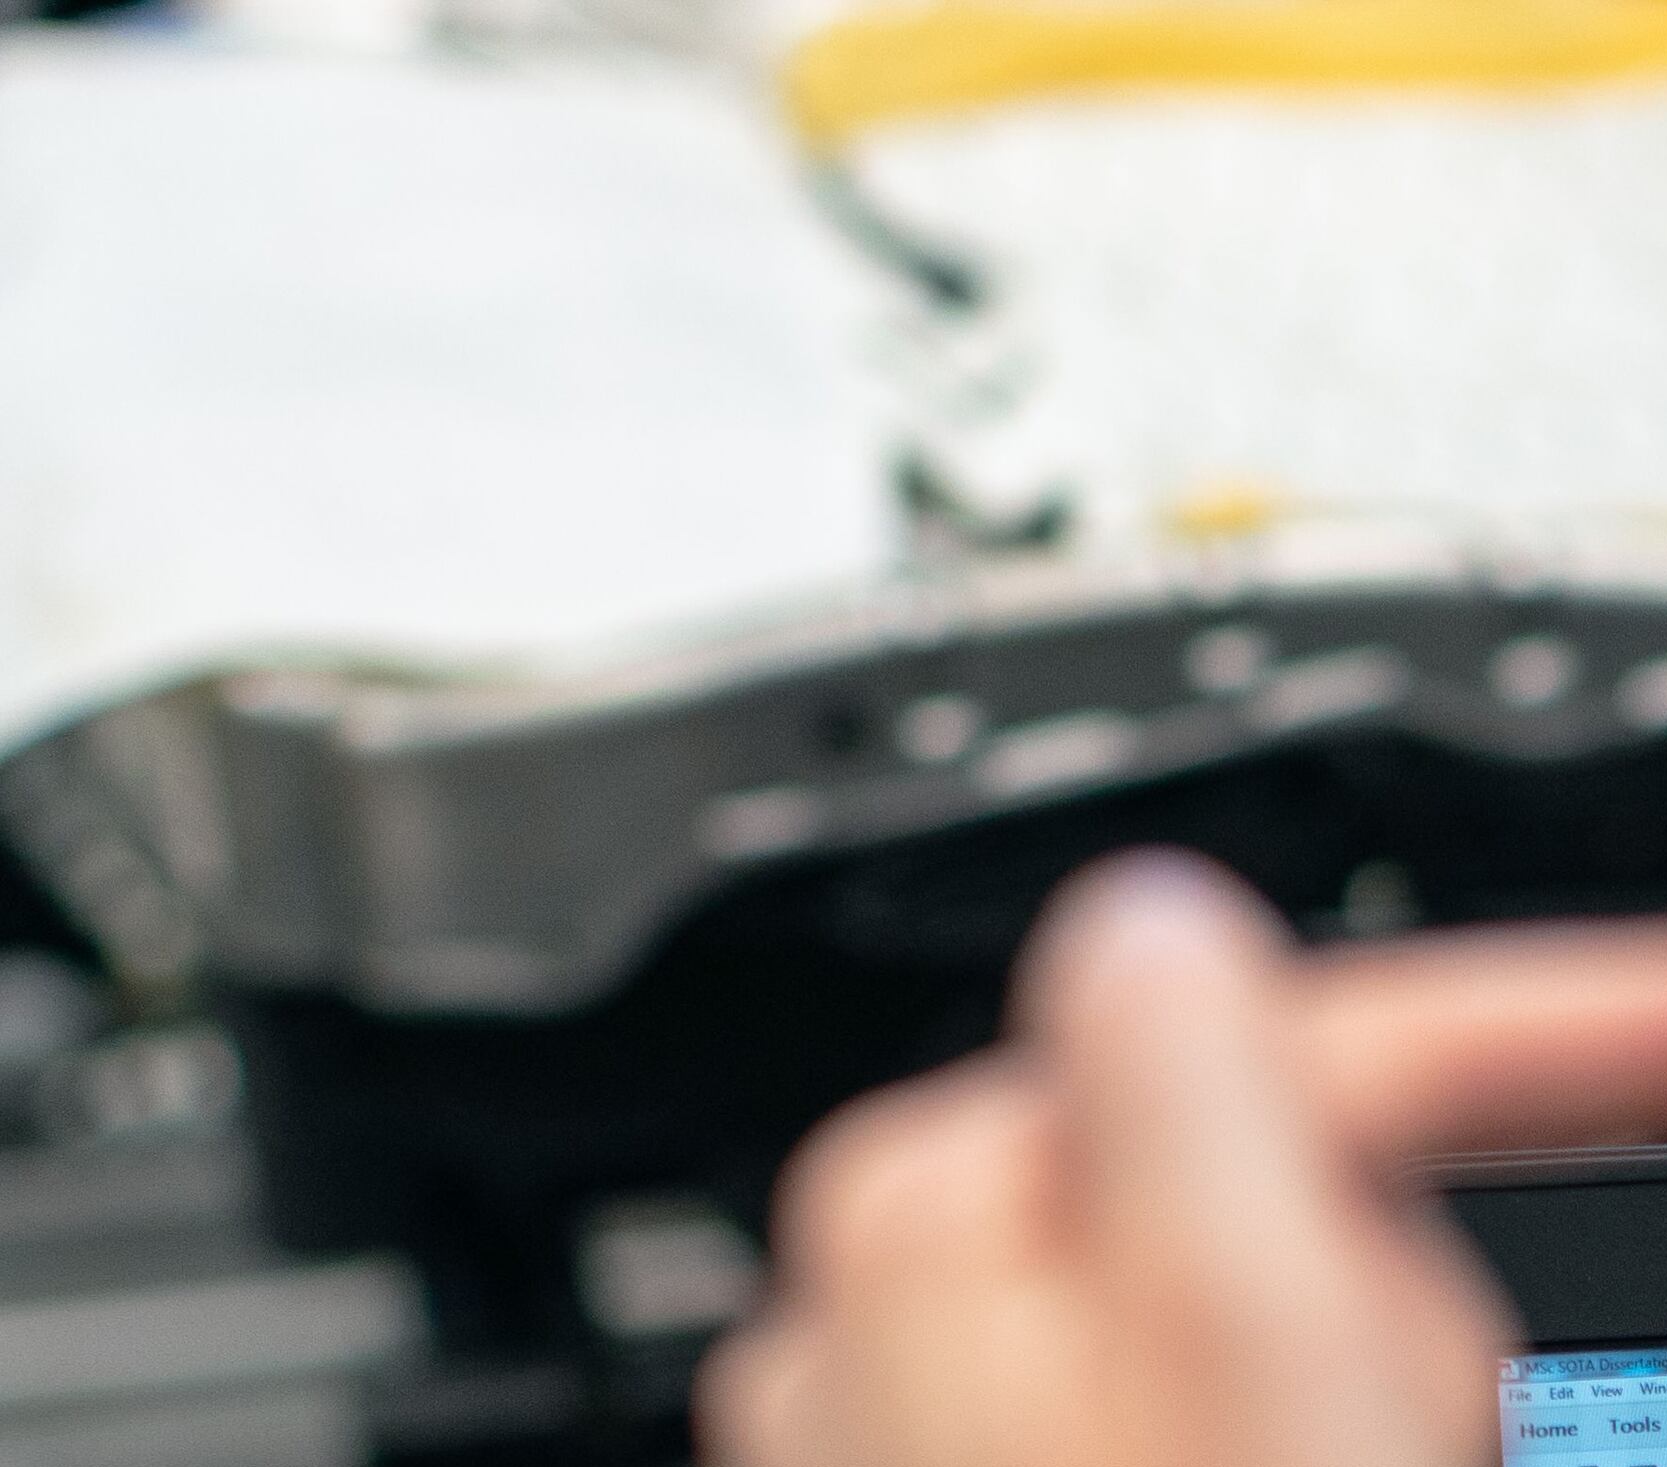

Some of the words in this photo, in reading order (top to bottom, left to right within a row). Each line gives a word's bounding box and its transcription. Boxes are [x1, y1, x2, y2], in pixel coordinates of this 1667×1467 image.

[1525, 1362, 1553, 1376] MSc
[1558, 1359, 1594, 1374] SOTA
[1550, 1388, 1574, 1400] Edit
[1591, 1385, 1623, 1398] View
[1521, 1423, 1578, 1439] Home
[1610, 1416, 1662, 1435] Tools
